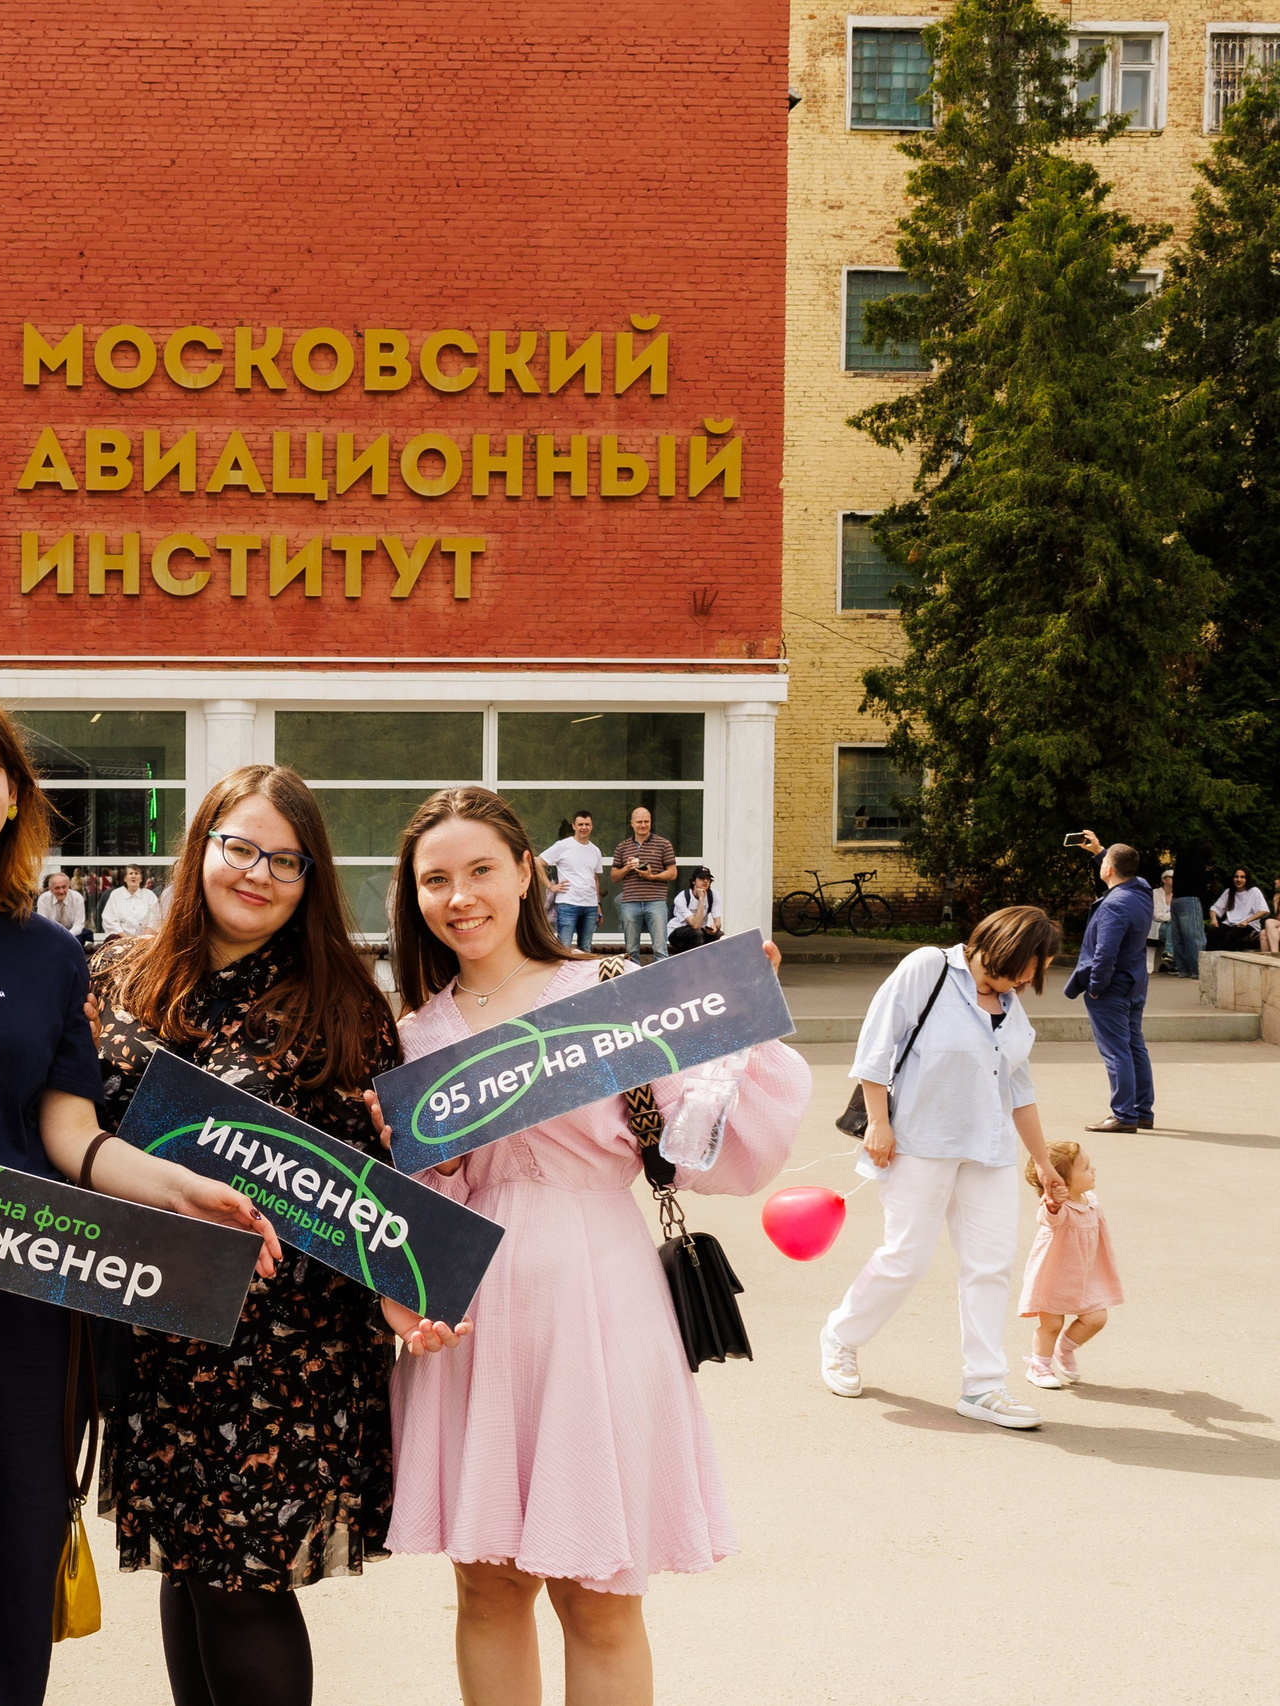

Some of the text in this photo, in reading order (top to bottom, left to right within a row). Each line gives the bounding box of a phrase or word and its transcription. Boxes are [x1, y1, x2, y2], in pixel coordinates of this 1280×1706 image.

[22, 313, 670, 397] МОСКОВСКИЙ
[17, 417, 743, 500] АВИАЦИОННЫЙ
[20, 531, 487, 600] ИНСТИТУТ
[428, 992, 727, 1121] 95 лет на высоте
[33, 1203, 102, 1241] фото
[196, 1116, 409, 1253] инженер
[229, 1174, 346, 1247] поменьше
